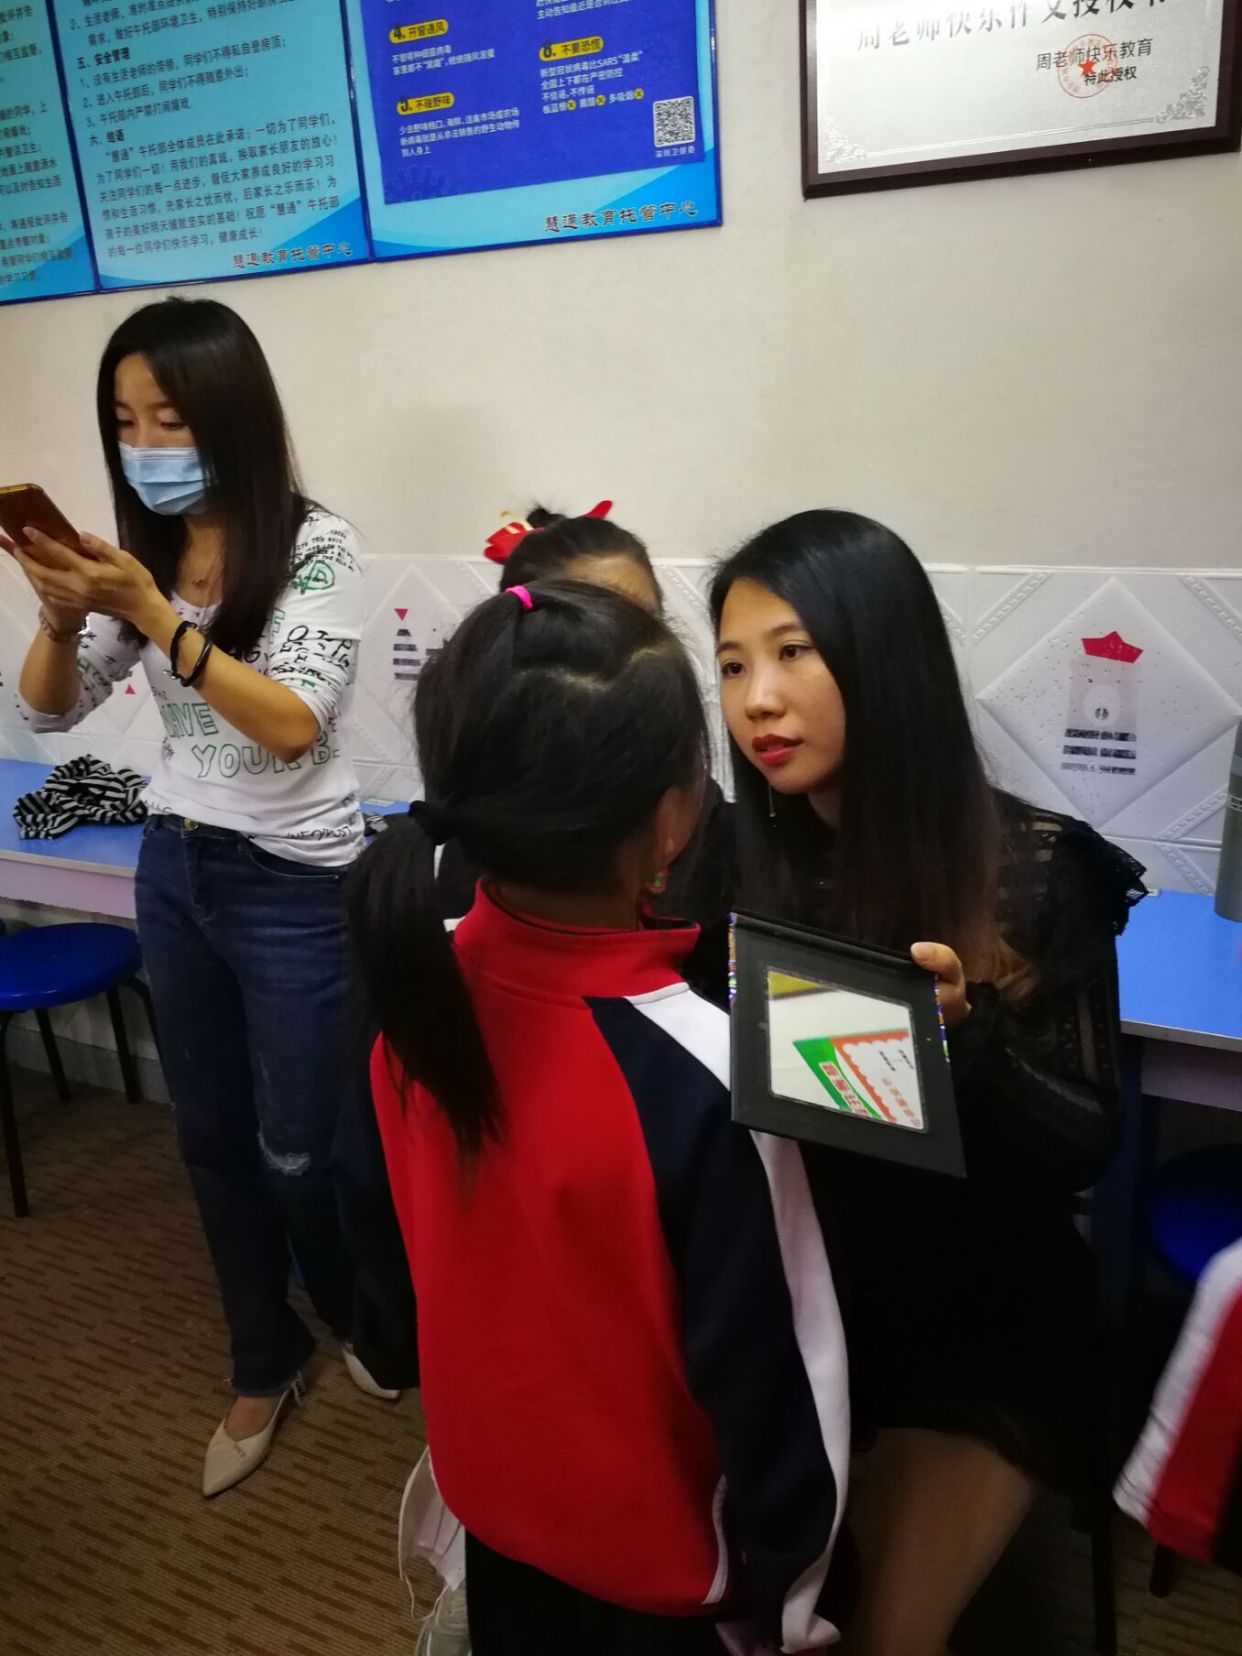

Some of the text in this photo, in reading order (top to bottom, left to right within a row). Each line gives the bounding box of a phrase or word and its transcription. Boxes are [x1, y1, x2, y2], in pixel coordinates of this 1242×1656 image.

[1036, 38, 1153, 71] 周老师快乐教育
[1084, 66, 1137, 86] 特此授权
